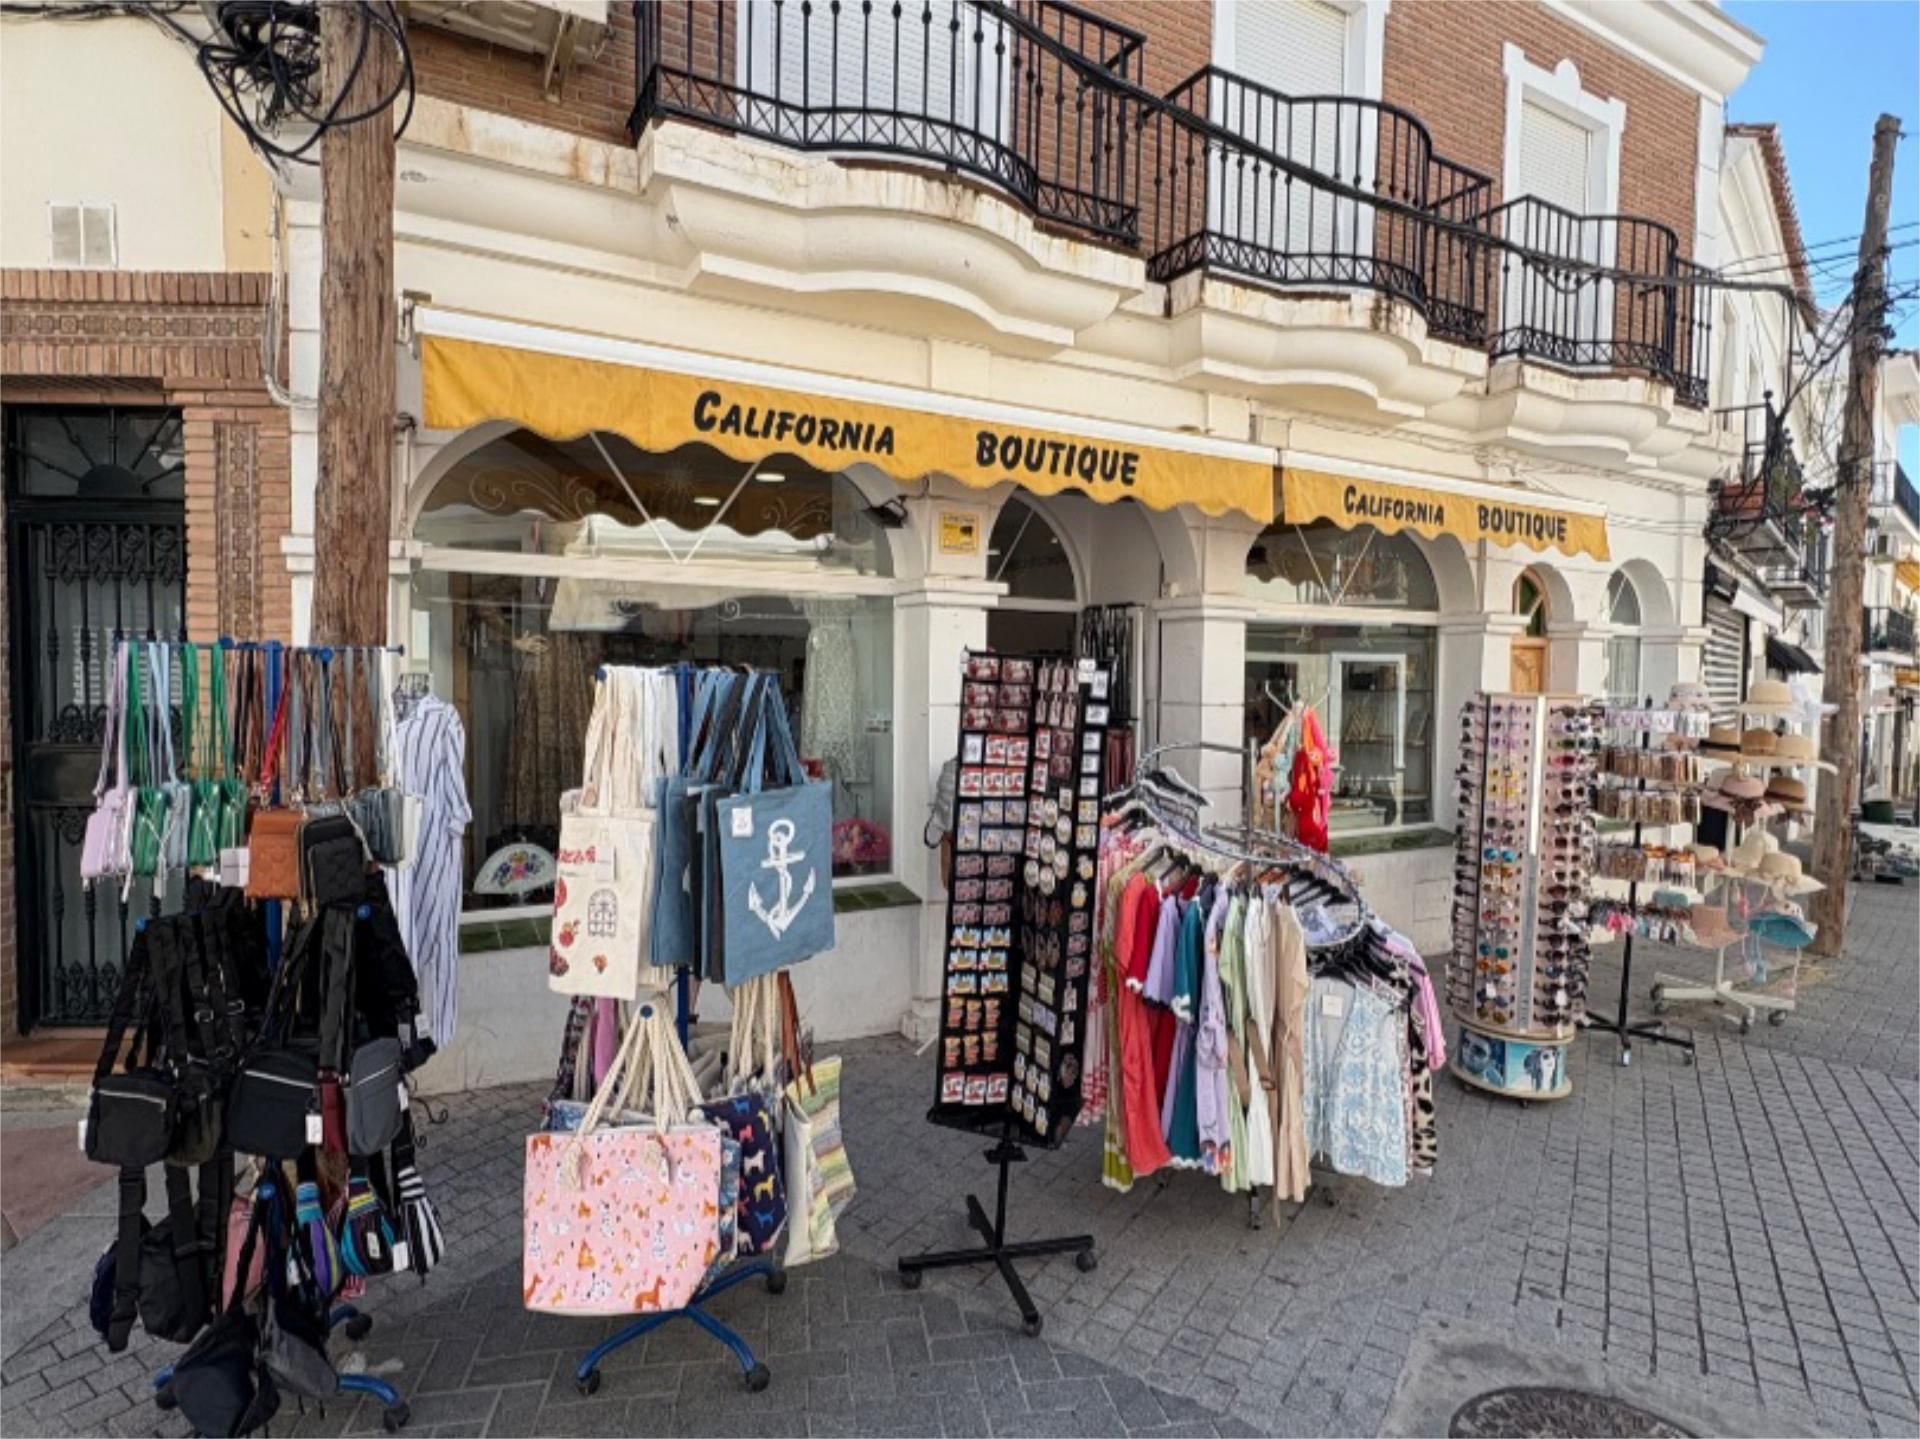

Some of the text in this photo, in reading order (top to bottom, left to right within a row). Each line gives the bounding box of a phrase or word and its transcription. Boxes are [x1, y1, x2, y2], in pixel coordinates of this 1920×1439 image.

[693, 391, 1139, 486] CALIFORNIA BOUTIQUE
[1344, 485, 1568, 542] CALIFORNIA BOUTIQUE
